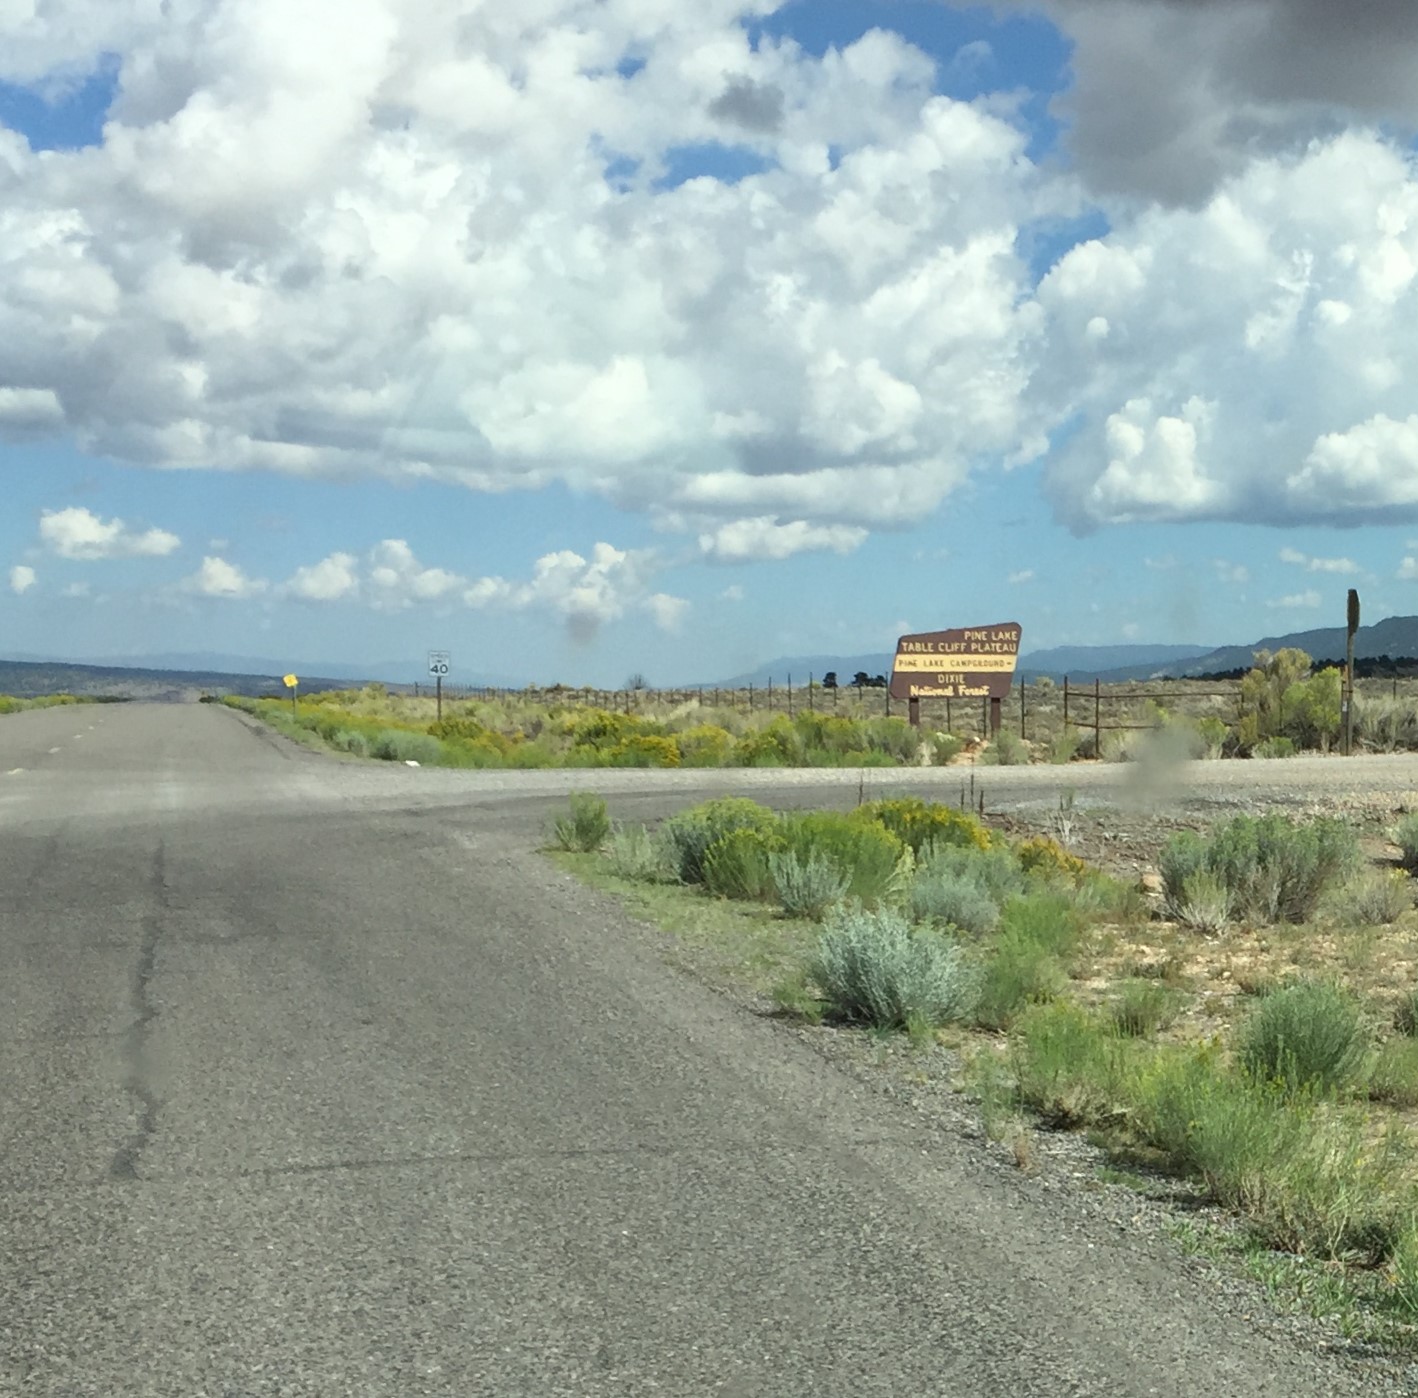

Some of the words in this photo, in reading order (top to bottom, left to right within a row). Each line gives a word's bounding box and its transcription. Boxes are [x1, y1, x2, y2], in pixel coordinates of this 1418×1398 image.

[964, 631, 988, 641] PINE
[991, 630, 1018, 641] LAKE
[901, 642, 934, 653] TABLE
[938, 641, 966, 652] CLIFF
[970, 642, 1017, 652] PLATEAU
[898, 659, 918, 668] PINE
[923, 659, 945, 668] LAKE
[949, 659, 1005, 668] CAMPGROUND
[430, 664, 448, 674] 40
[937, 674, 966, 684] DIXIE
[909, 685, 955, 697] National
[957, 685, 990, 697] Forest
